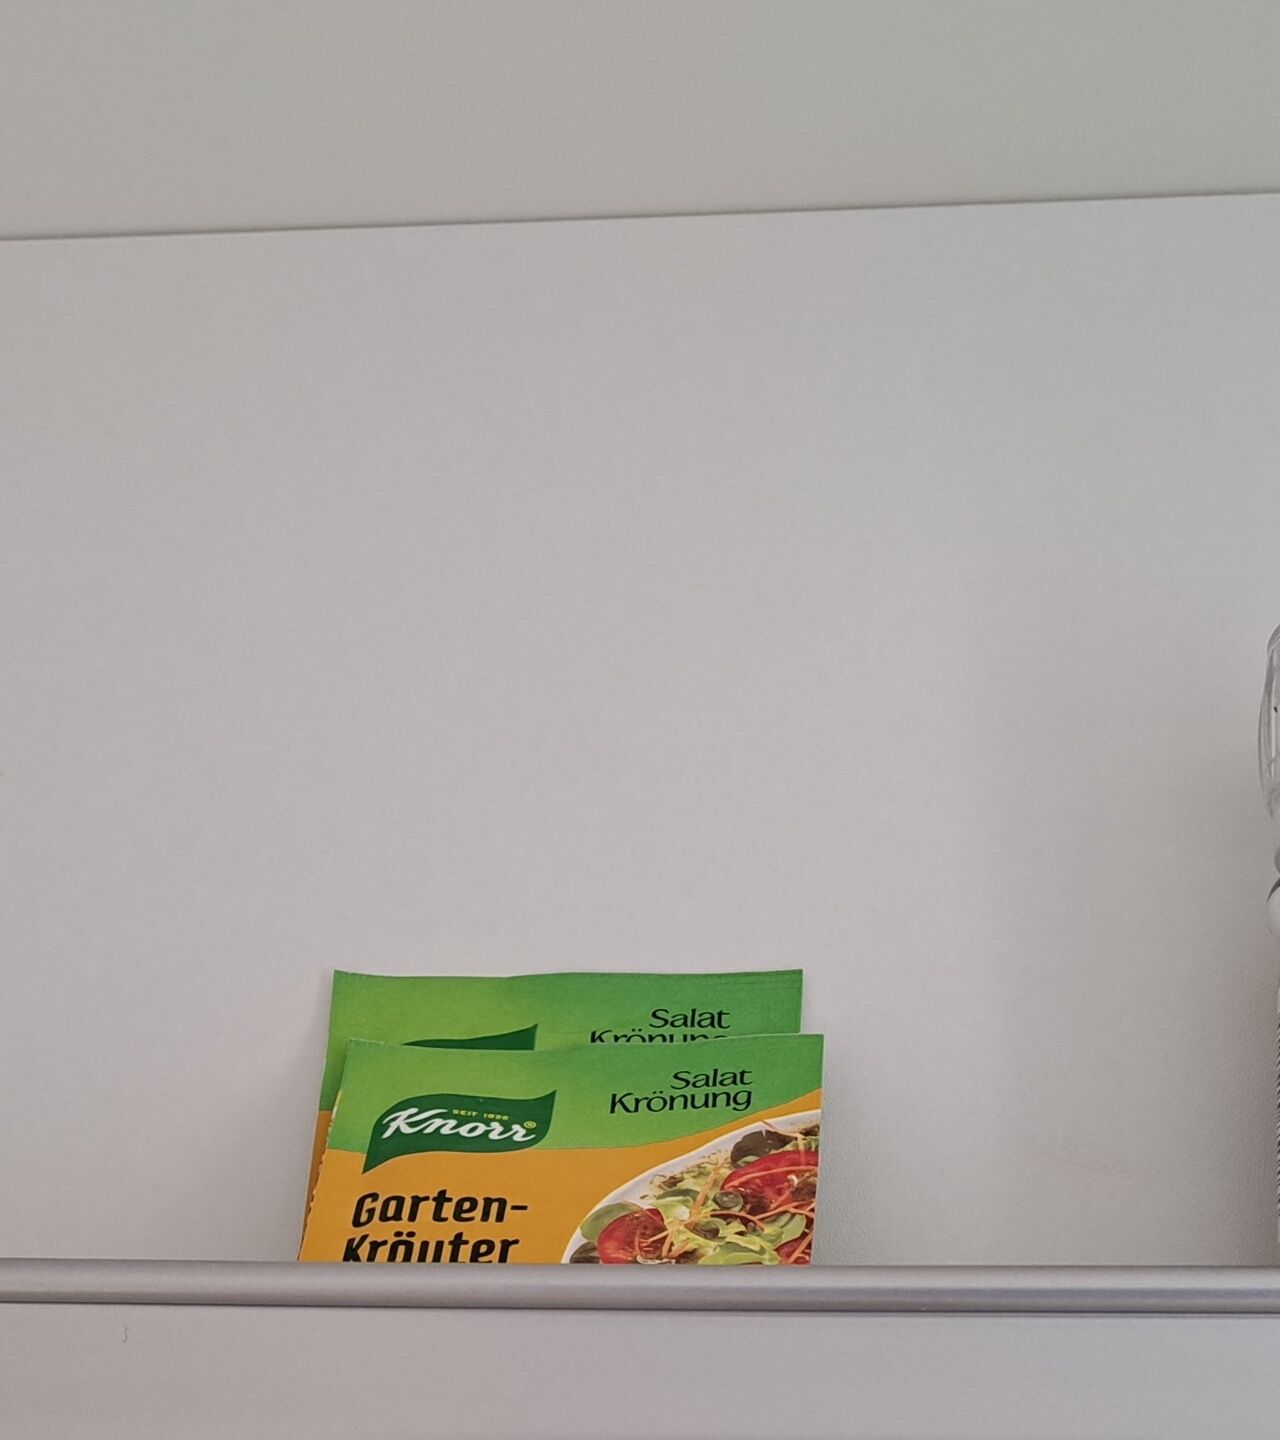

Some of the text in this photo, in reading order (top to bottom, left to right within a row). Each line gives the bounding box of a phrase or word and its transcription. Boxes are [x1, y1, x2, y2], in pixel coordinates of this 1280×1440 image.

[649, 1008, 731, 1028] Salat
[670, 1068, 752, 1089] Salat
[609, 1090, 752, 1114] Krönung
[381, 1107, 535, 1142] Knorr
[351, 1189, 528, 1228] Garten-
[342, 1231, 520, 1263] Kräuter
